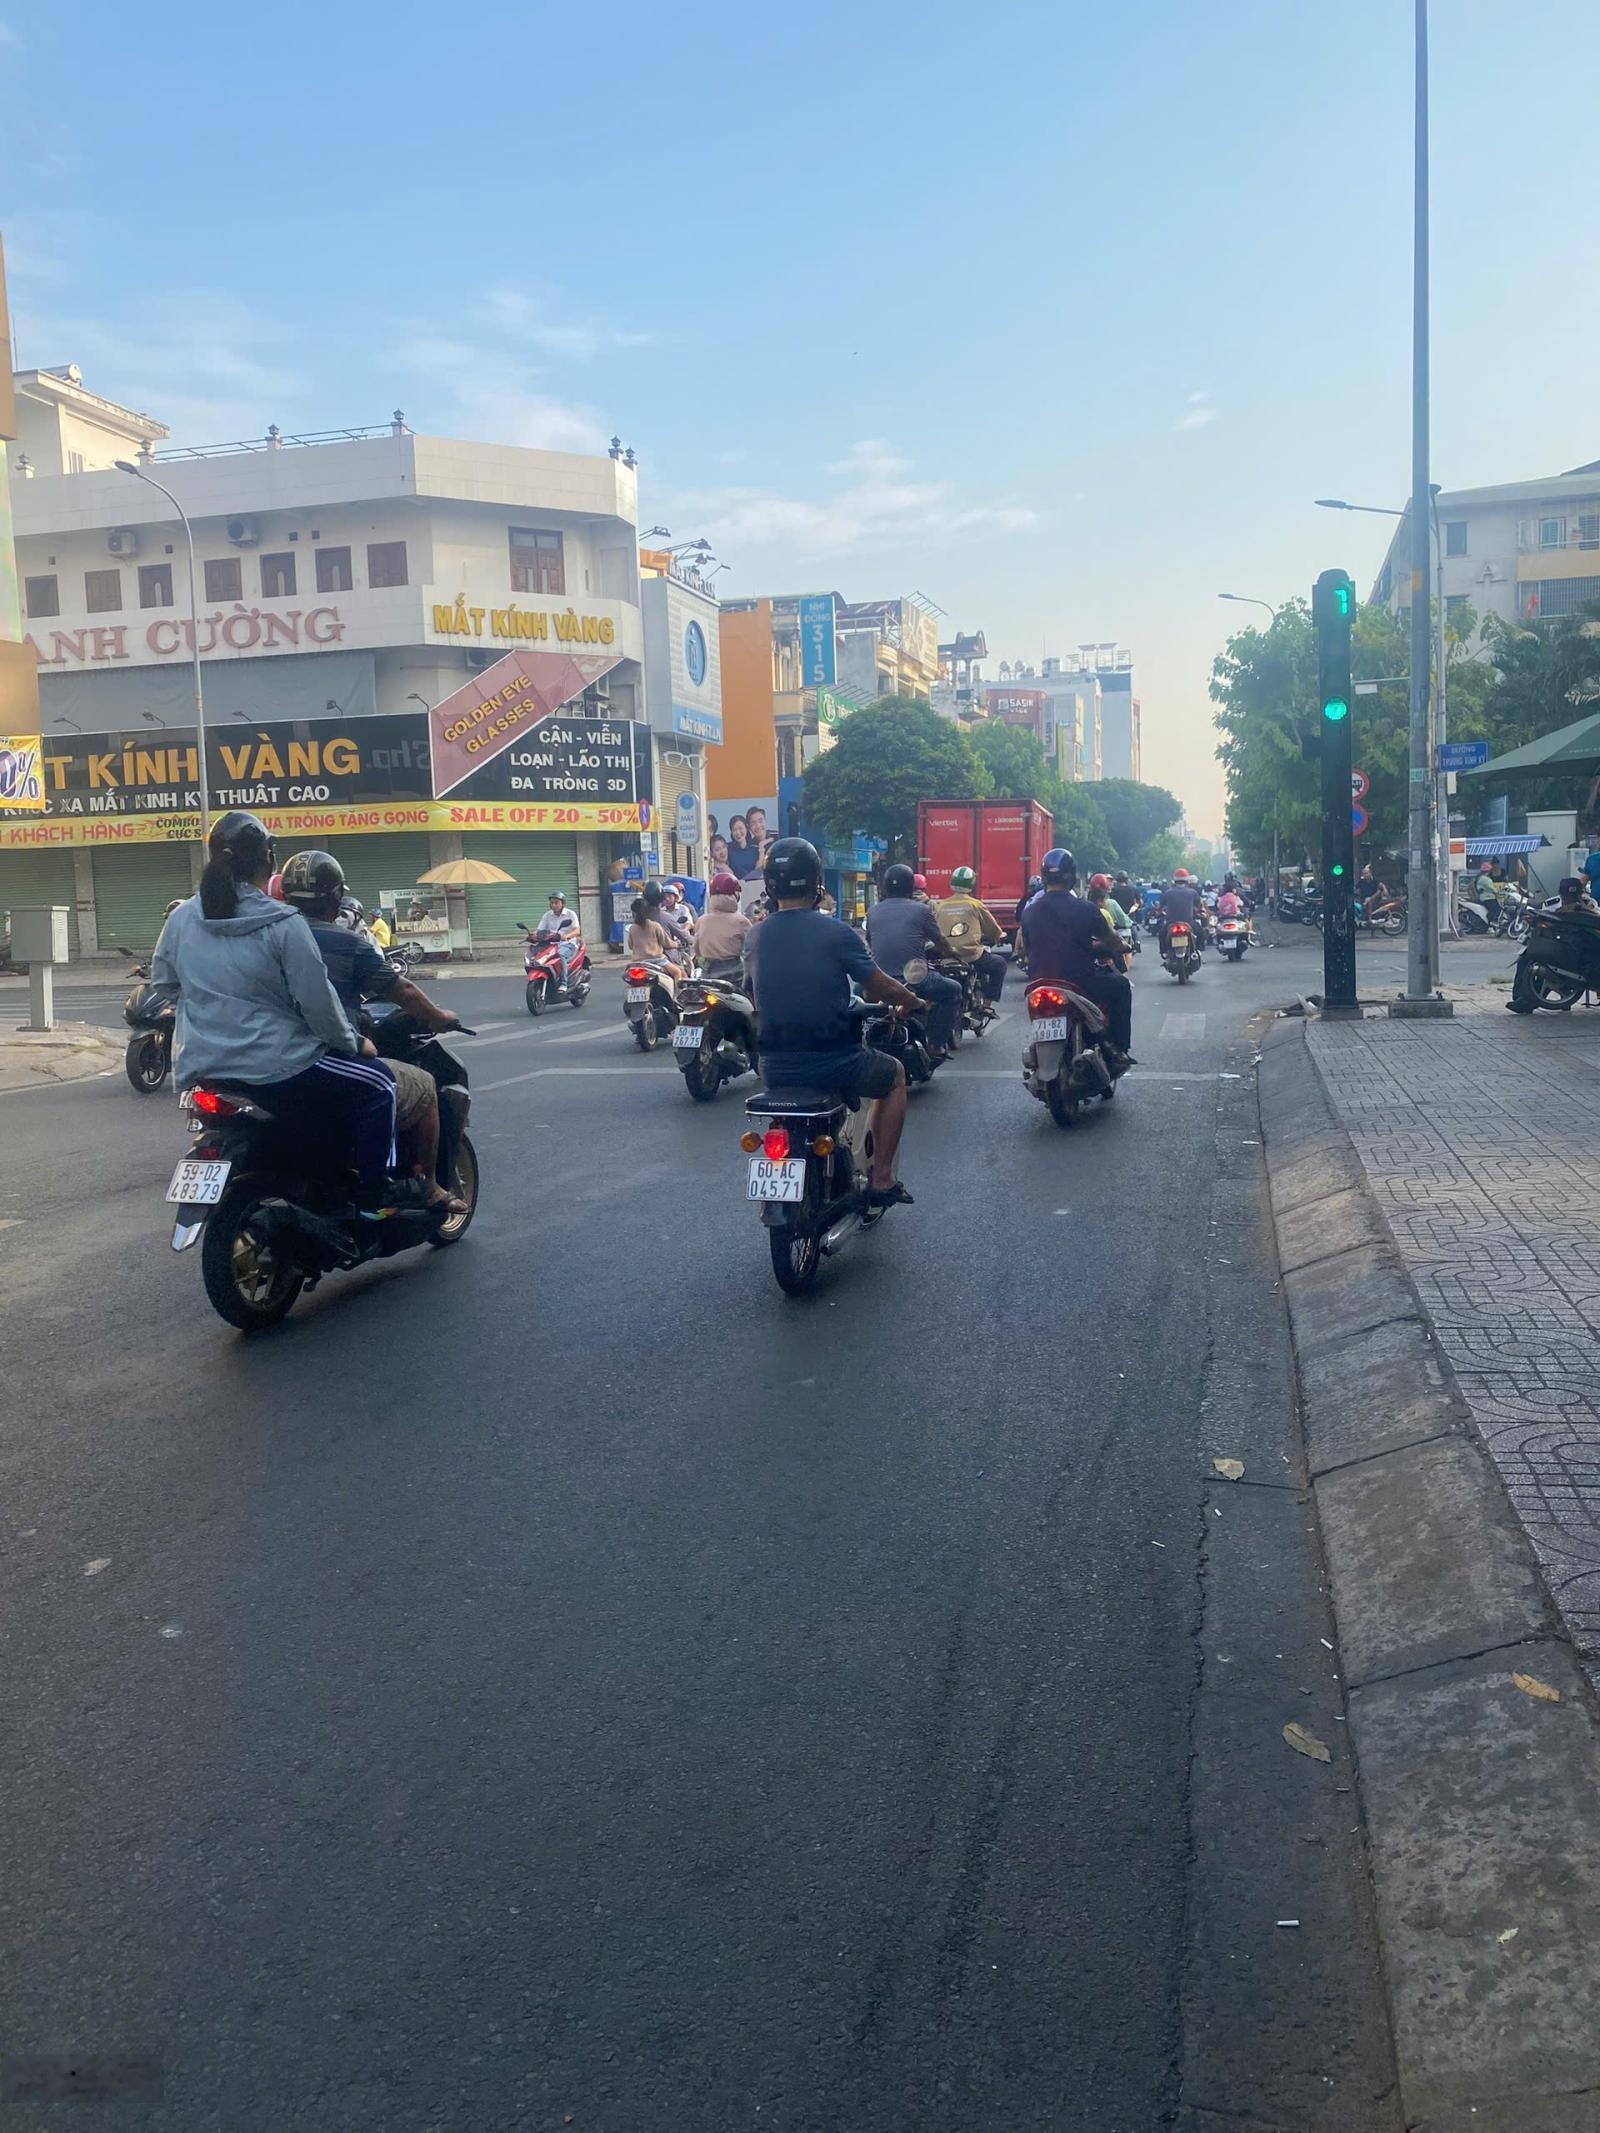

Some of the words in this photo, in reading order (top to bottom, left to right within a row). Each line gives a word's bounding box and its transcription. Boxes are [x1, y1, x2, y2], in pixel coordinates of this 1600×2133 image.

[146, 603, 346, 654] CƯỜNG
[433, 592, 486, 636] MẮT
[491, 603, 548, 640] KÍNH
[552, 607, 615, 645] VÀNG
[444, 695, 503, 742] GOLDEN
[502, 674, 532, 700] EYE
[466, 698, 535, 753] GLASSES
[539, 725, 573, 747] CẬN
[587, 723, 622, 745] VIỄN
[88, 741, 199, 788] KÍNH
[220, 733, 361, 780] VÀNG
[510, 753, 553, 769] LOẠN
[604, 756, 630, 771] THỊ
[511, 777, 534, 790] ĐA
[543, 770, 598, 790] TRÒNG
[607, 779, 627, 791] 3D
[89, 788, 127, 812] MẮT
[288, 784, 330, 801] CAO
[156, 817, 200, 830] COMBO
[286, 811, 335, 828] TRÒNG
[340, 811, 380, 829] TẶNG
[384, 810, 429, 827] GỌNG
[450, 808, 504, 823] SALE
[509, 808, 548, 823] OFF
[553, 808, 580, 823] 20
[597, 809, 639, 824] 50%
[10, 824, 74, 844] KHÁCH
[83, 820, 134, 840] HÀNG
[182, 1164, 221, 1181] 59-D2
[171, 1182, 220, 1201] 483.79
[750, 1180, 800, 1199] 045.71
